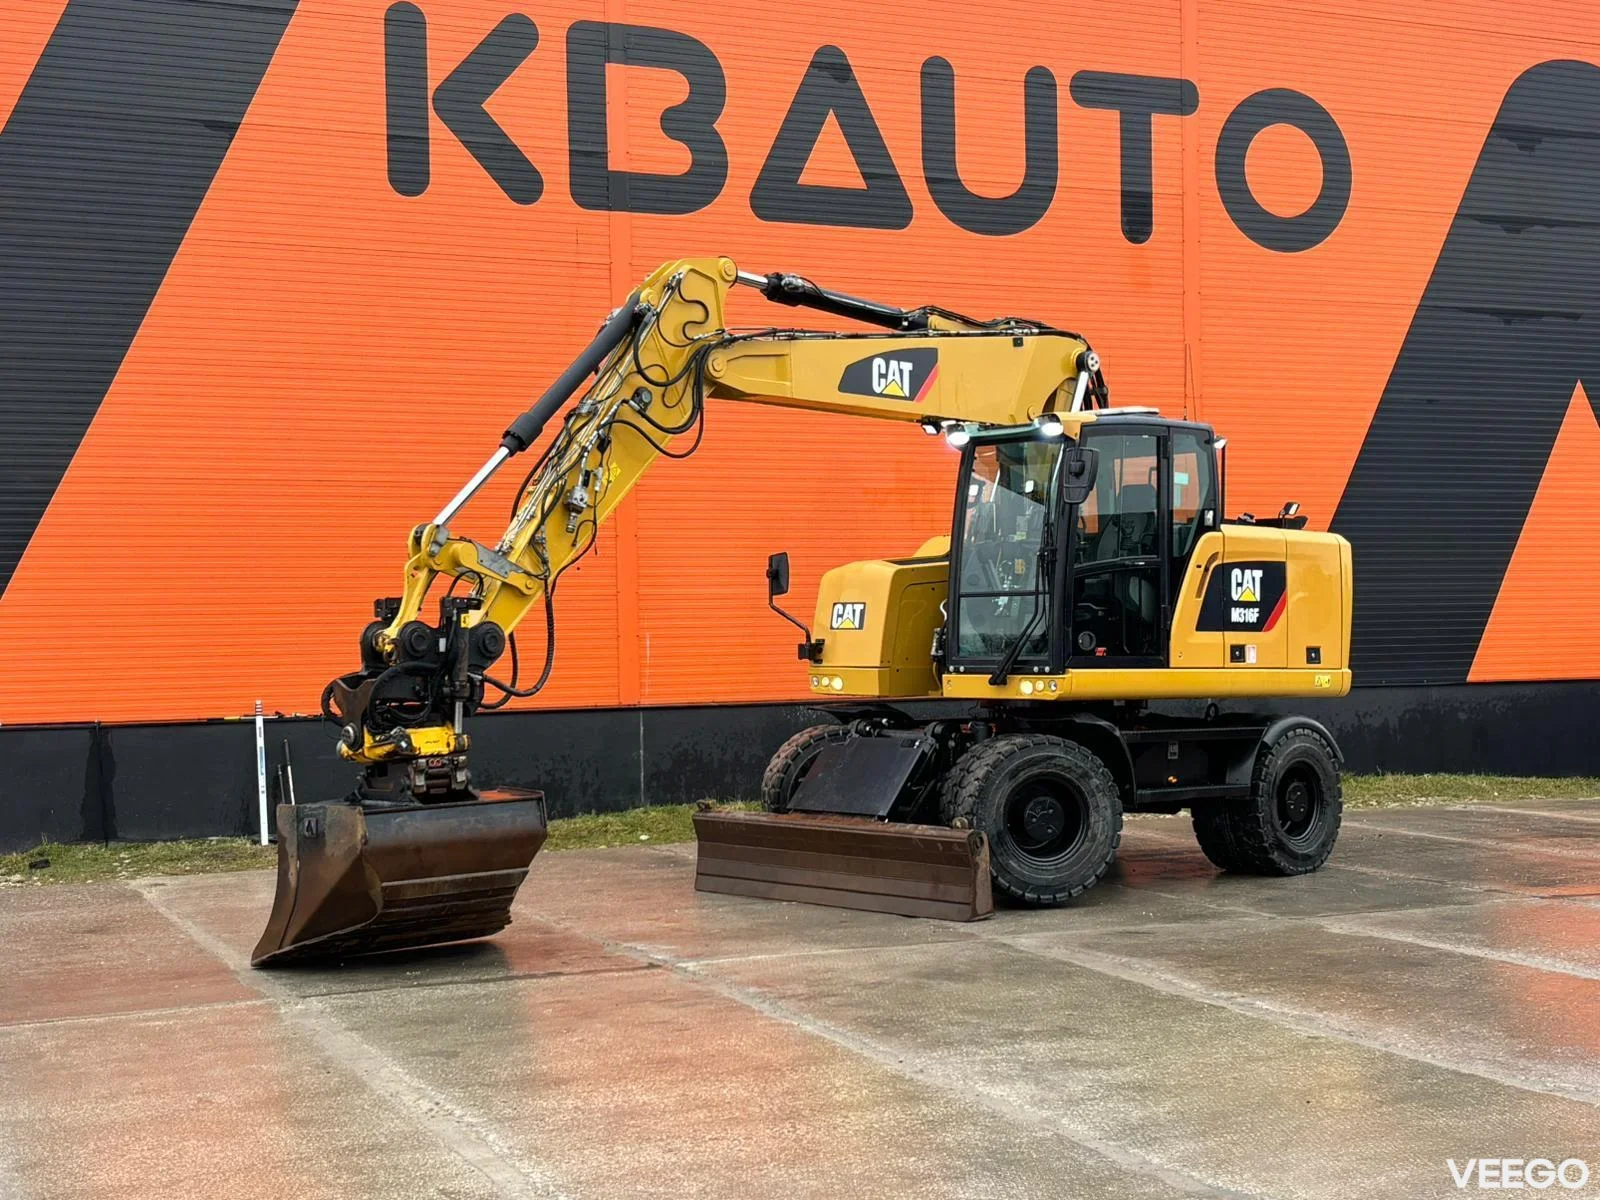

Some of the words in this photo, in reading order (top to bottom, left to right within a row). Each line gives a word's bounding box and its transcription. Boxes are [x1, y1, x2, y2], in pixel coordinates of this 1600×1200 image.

[872, 357, 913, 397] CAT
[1231, 568, 1263, 602] CAT
[831, 603, 865, 629] CAT
[1231, 607, 1260, 623] M316F
